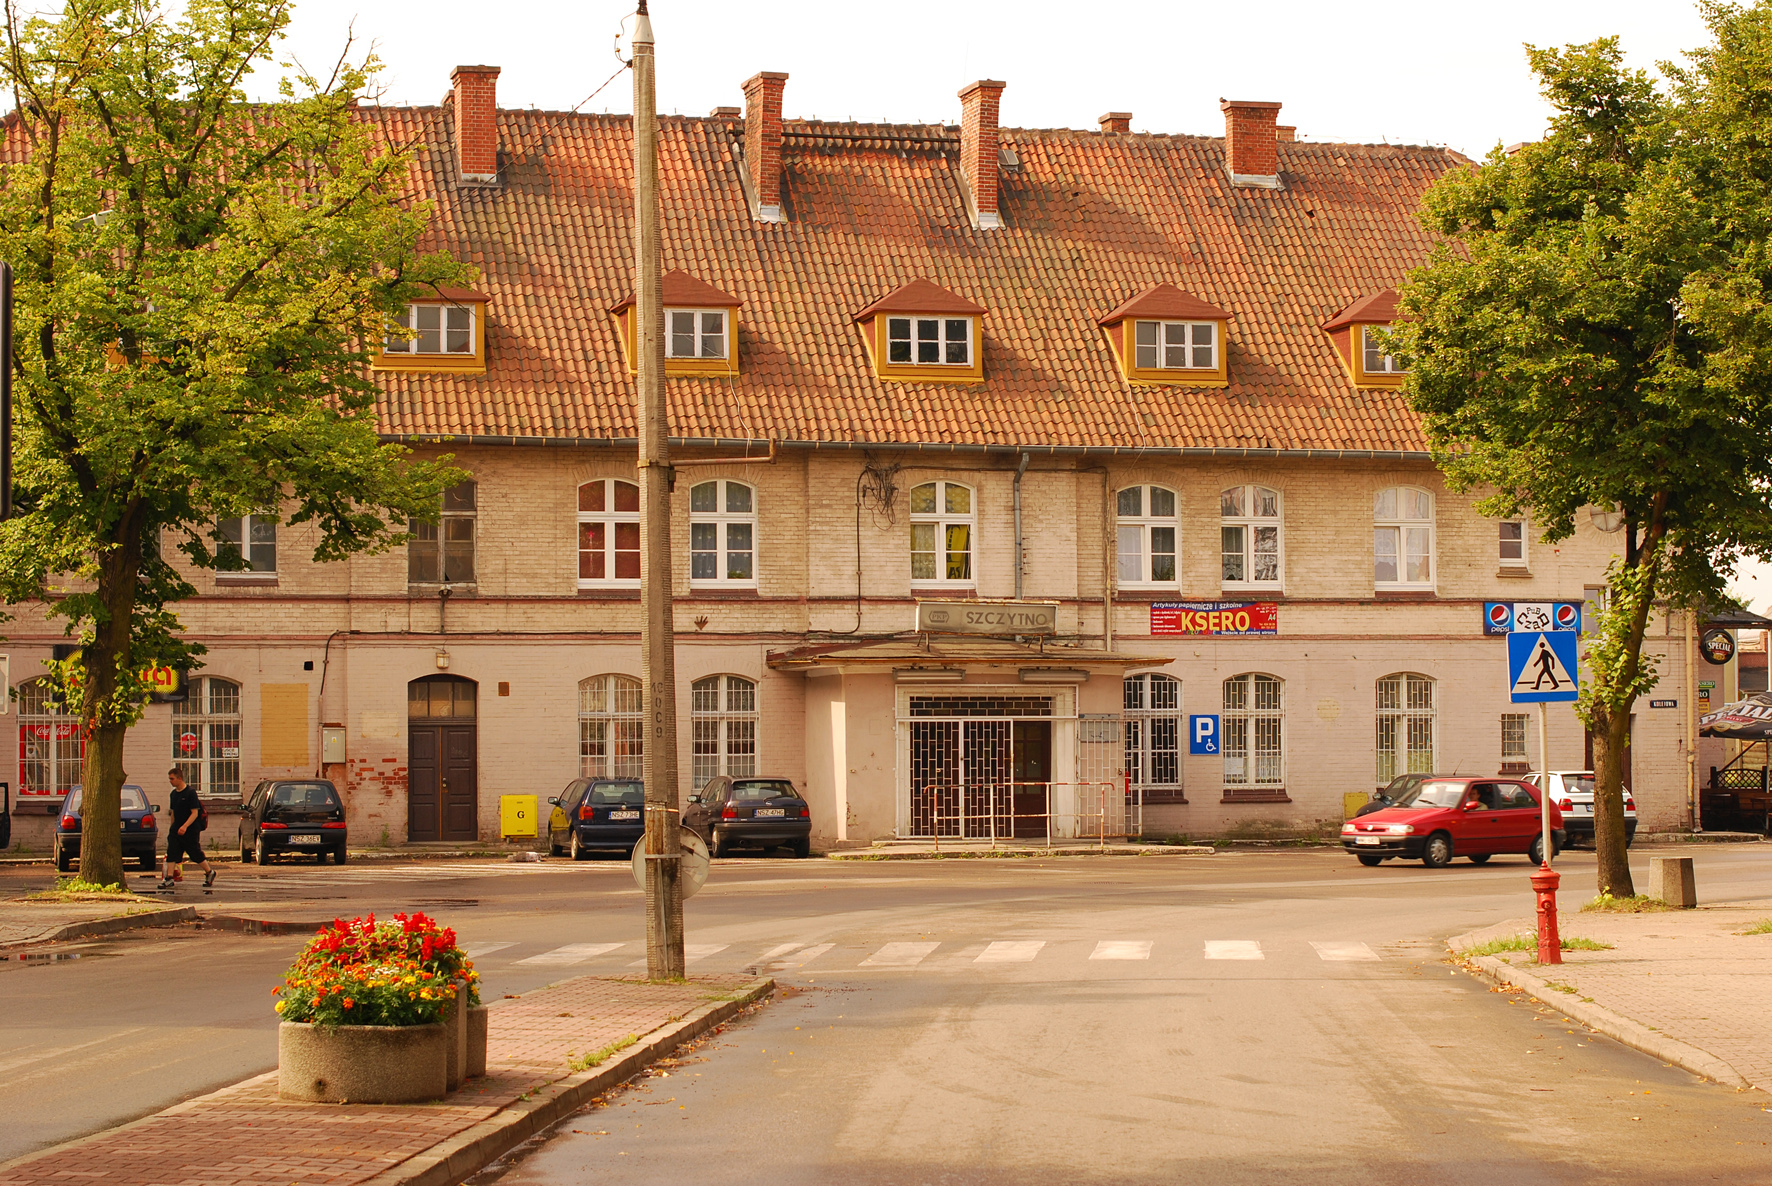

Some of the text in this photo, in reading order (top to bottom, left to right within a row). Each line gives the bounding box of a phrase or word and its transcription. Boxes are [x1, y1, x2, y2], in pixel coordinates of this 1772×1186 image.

[966, 611, 1048, 626] SZCZYTNO
[1181, 611, 1250, 631] KSERO
[1268, 613, 1276, 621] A4
[36, 726, 70, 736] CocaCola
[1195, 717, 1214, 743] P
[517, 810, 525, 819] G
